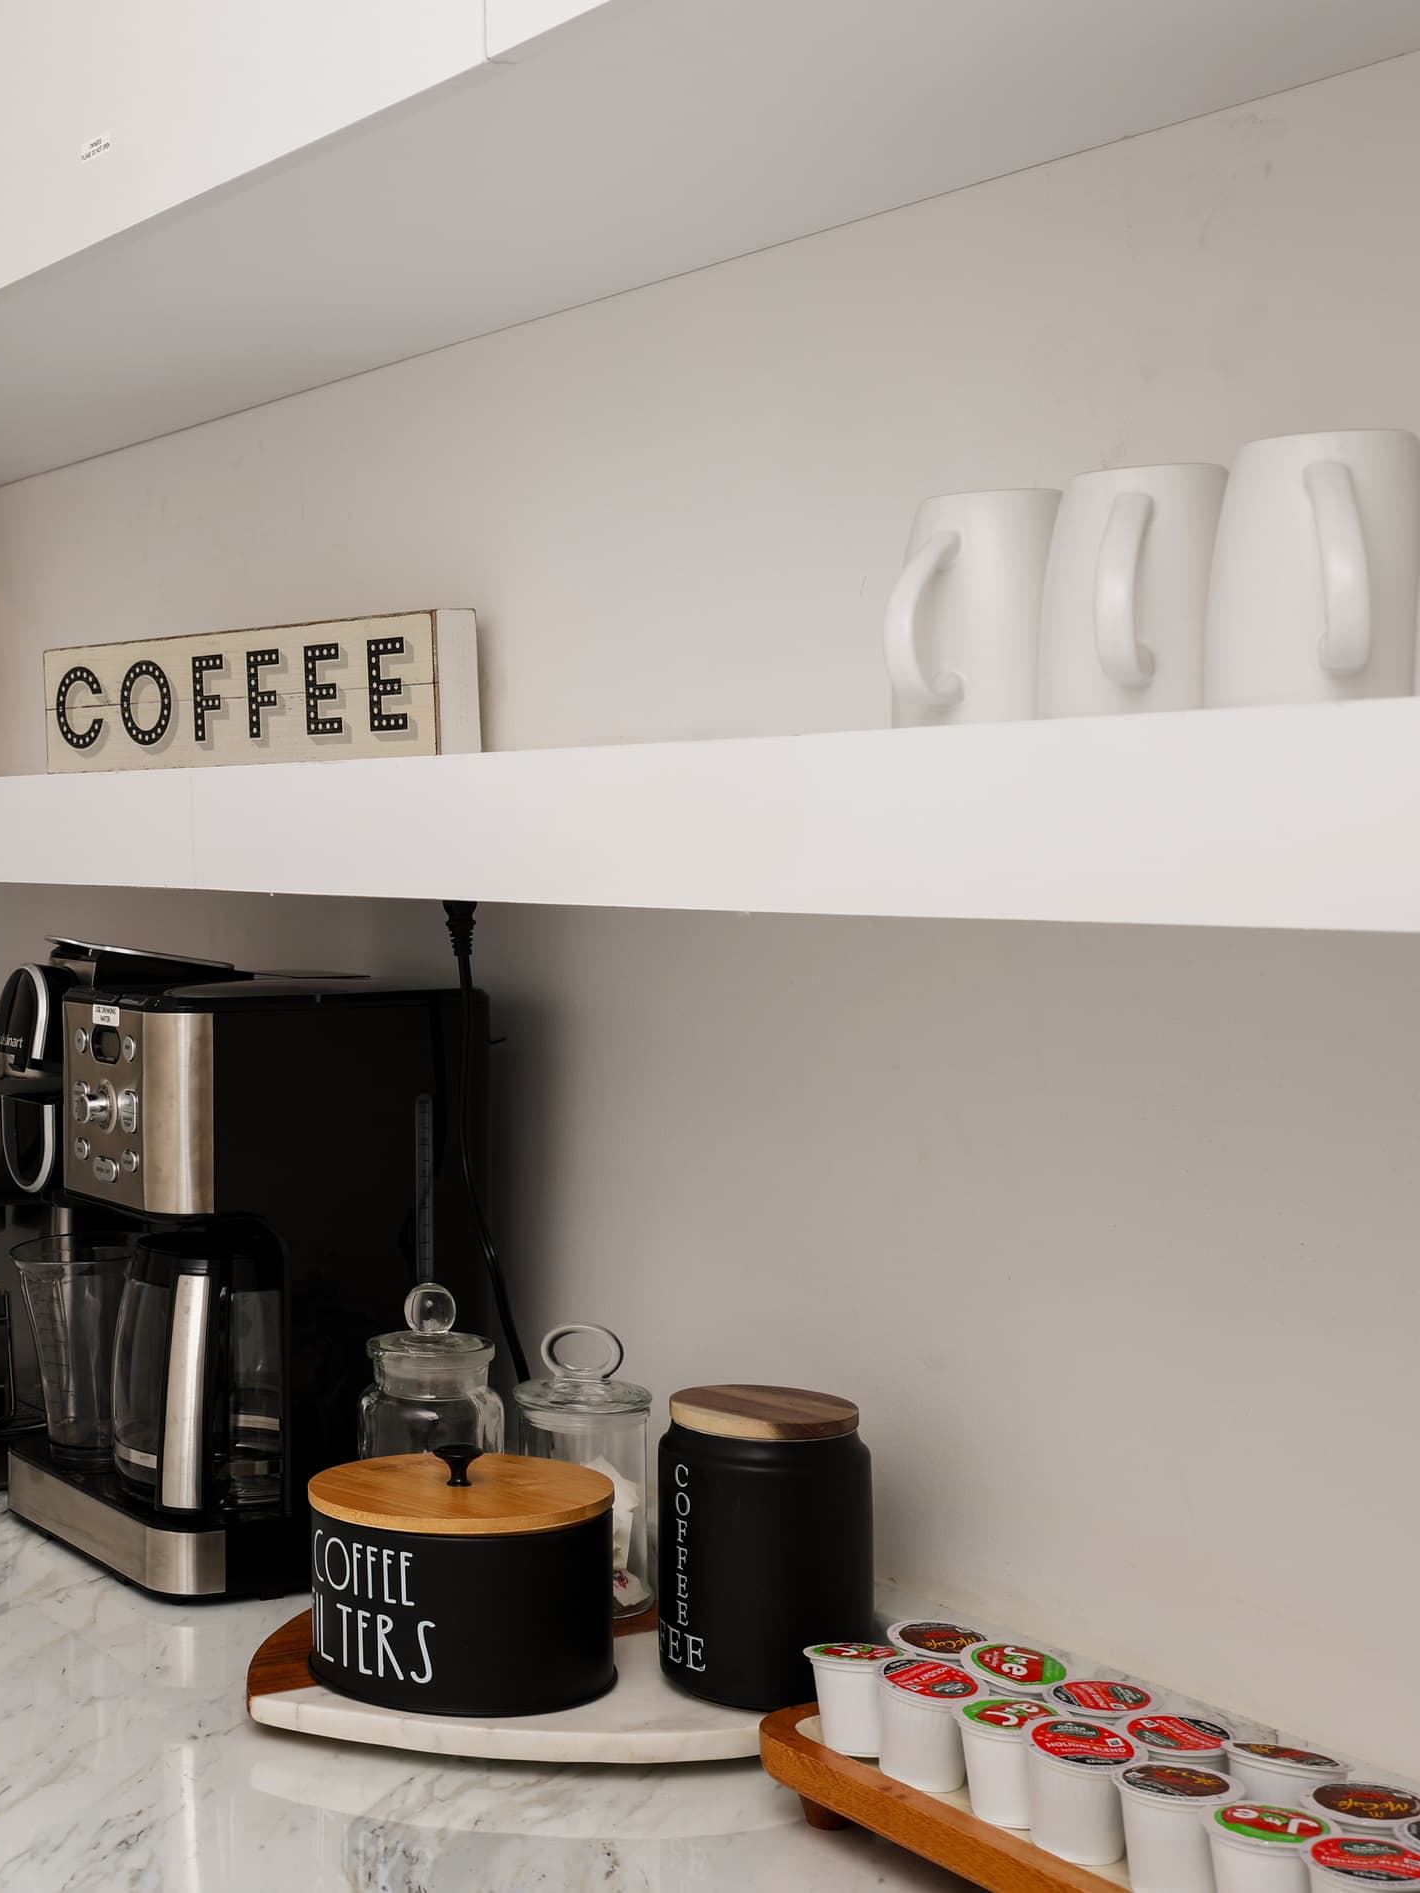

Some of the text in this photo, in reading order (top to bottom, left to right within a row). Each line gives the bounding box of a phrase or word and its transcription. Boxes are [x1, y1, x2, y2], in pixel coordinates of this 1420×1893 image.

[55, 636, 409, 750] COFFEE
[313, 1528, 416, 1607] COFFEE
[674, 1463, 691, 1627] COFFEE
[659, 1618, 707, 1672] FEE
